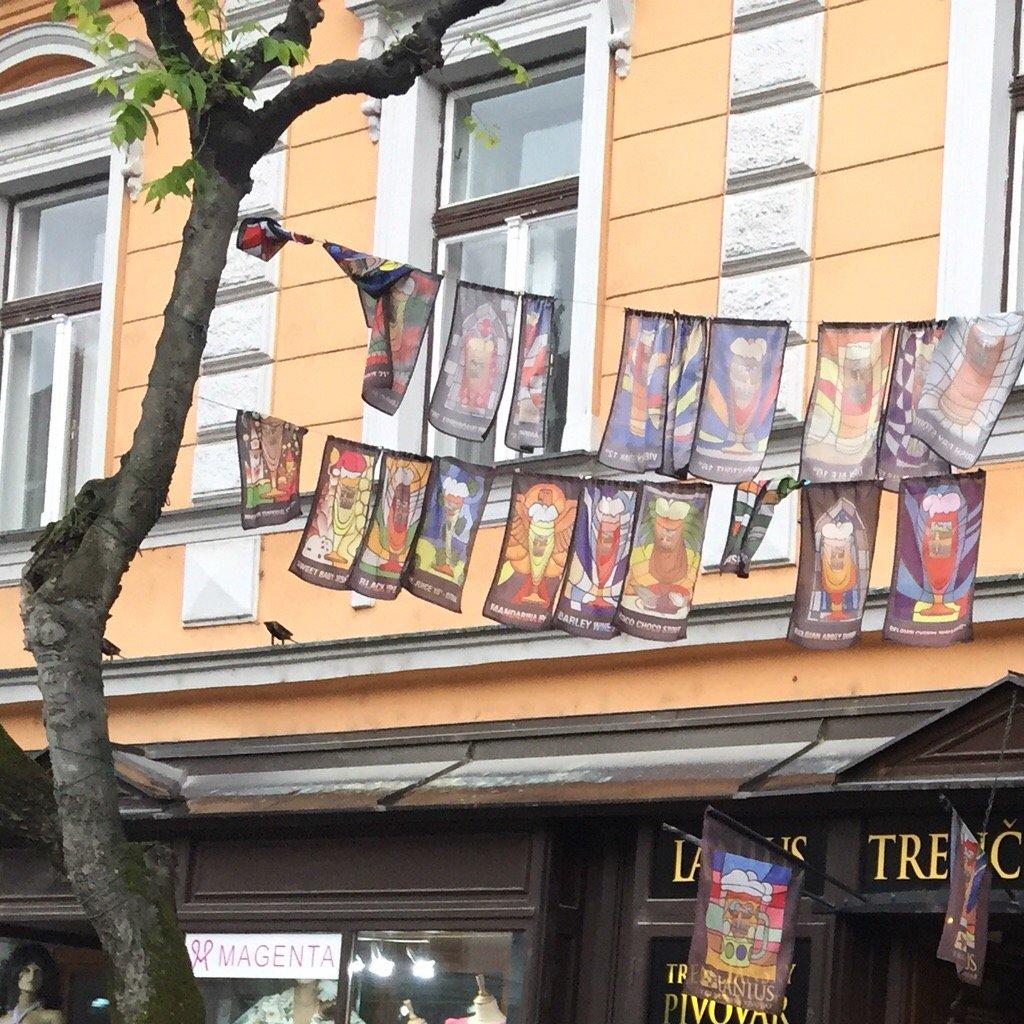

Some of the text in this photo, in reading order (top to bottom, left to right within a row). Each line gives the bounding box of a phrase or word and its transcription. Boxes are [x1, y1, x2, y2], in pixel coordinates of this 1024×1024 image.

[490, 602, 538, 622] MANDARINA
[558, 611, 593, 630] BARLEY
[636, 620, 661, 633] CHOCO
[218, 944, 335, 968] MAGENTA
